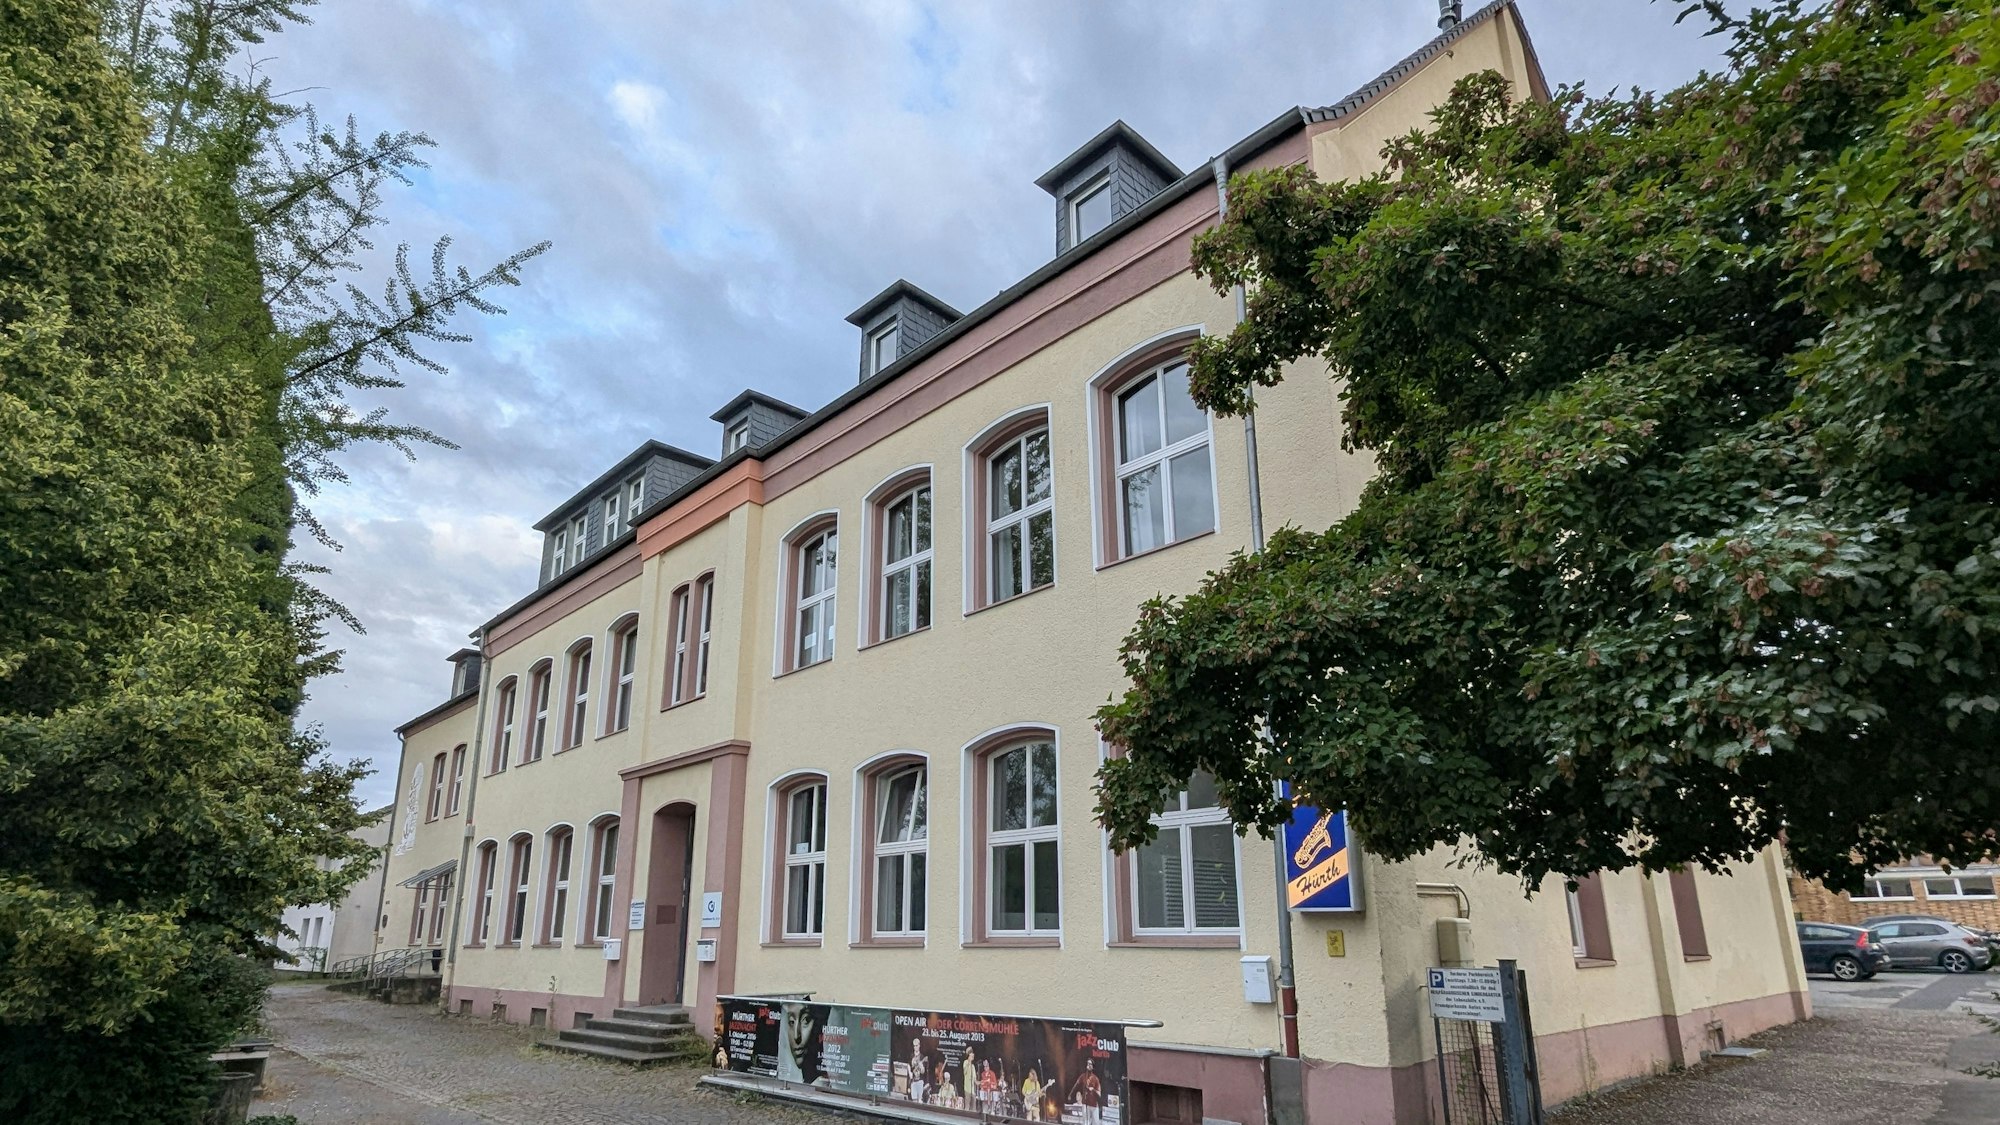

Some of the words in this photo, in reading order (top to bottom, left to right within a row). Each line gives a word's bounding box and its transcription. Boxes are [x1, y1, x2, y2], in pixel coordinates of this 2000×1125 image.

[1296, 858, 1340, 896] Hürth
[1432, 972, 1441, 986] P
[732, 1011, 755, 1022] HÜRTHER
[822, 1025, 848, 1036] HÜRTHER
[895, 1016, 913, 1026] OPEN
[914, 1016, 927, 1027] AIR
[937, 1020, 952, 1030] DER
[954, 1021, 1019, 1035] CORRENSMÜHLE
[922, 1028, 930, 1038] 23.
[931, 1028, 939, 1038] bis
[940, 1030, 948, 1039] 25.
[949, 1031, 970, 1041] August
[971, 1033, 984, 1042] 2013
[828, 1044, 841, 1053] 2012
